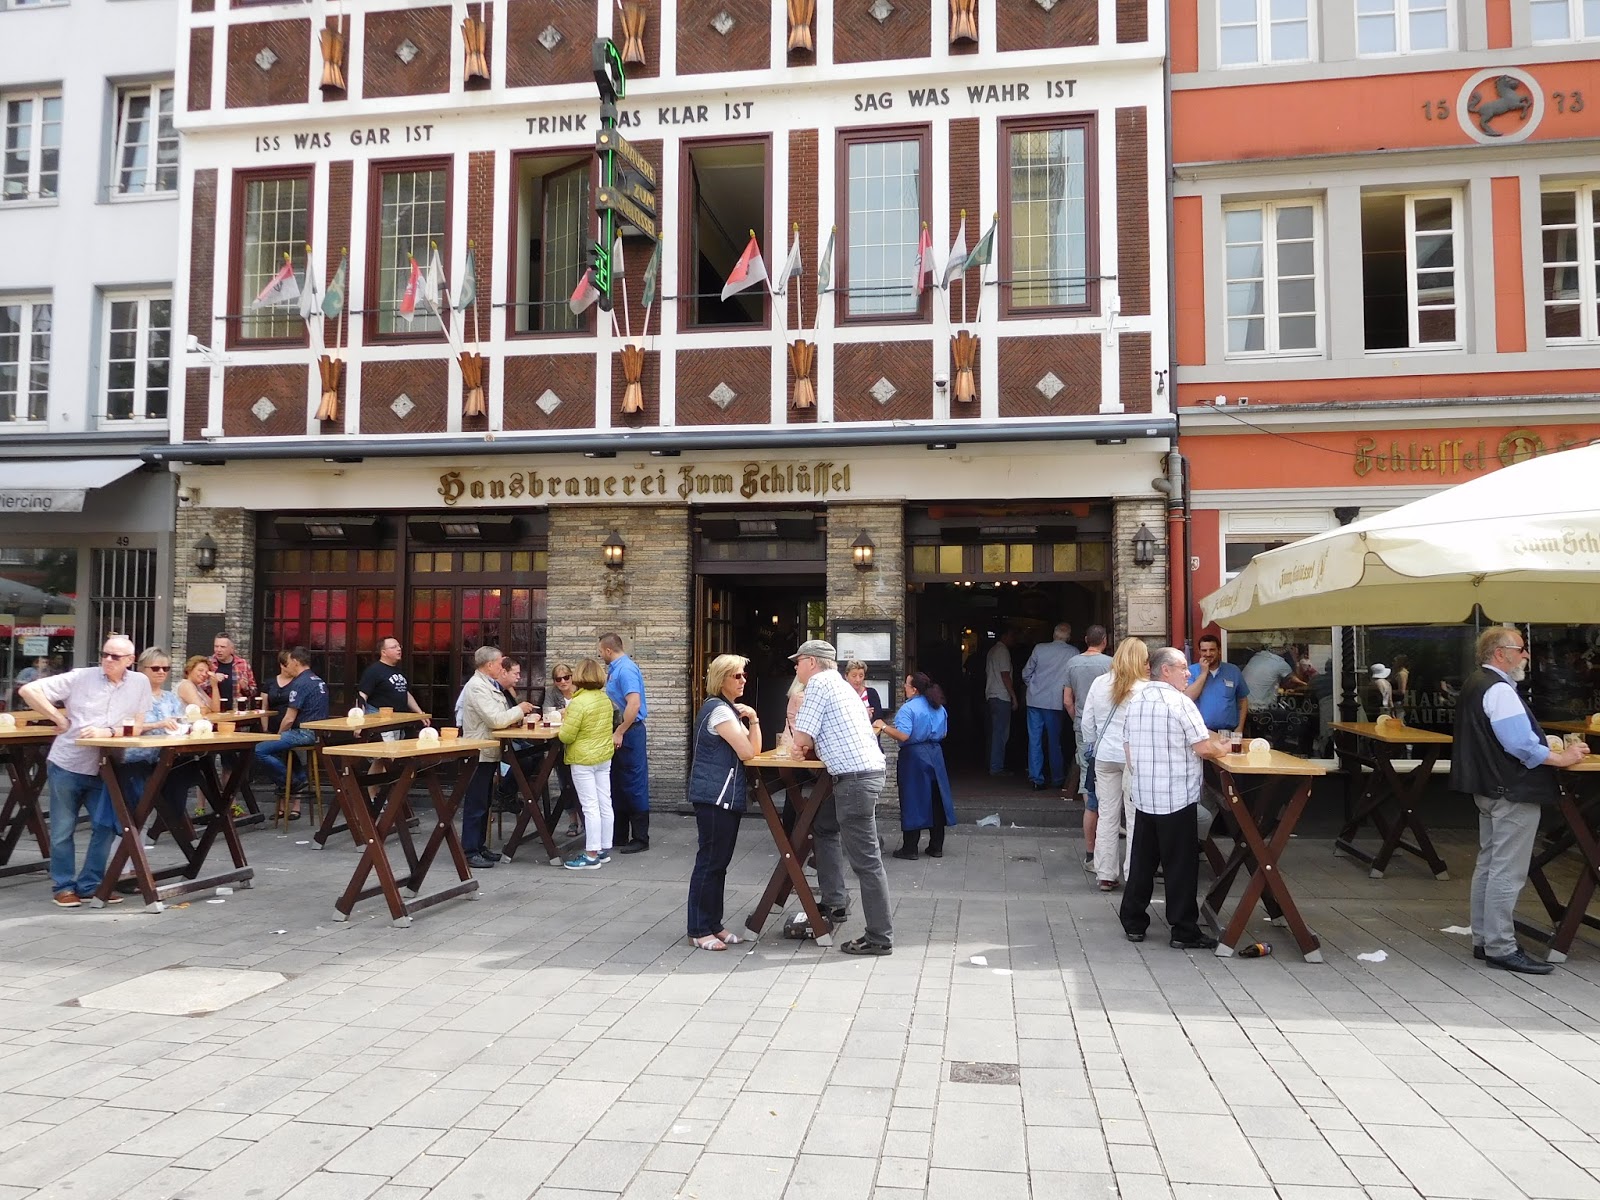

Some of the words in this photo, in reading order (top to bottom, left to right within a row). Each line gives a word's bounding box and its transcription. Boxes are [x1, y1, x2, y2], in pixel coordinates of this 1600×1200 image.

[854, 92, 893, 112] SAG
[908, 87, 949, 107] WAS
[967, 83, 1030, 103] WAHR
[1047, 79, 1077, 98] IST
[1422, 100, 1450, 121] 15
[1552, 91, 1585, 114] 73
[526, 114, 587, 134] TRINK
[617, 110, 641, 129] AS
[658, 105, 708, 125] KLAR
[725, 101, 754, 121] IST
[256, 136, 281, 152] ISS
[294, 132, 331, 150] WAS
[350, 127, 390, 146] GAR
[406, 125, 434, 143] IST
[633, 183, 655, 211] ZUM
[677, 465, 733, 500] Zum
[739, 461, 850, 500] Schlüssel
[0, 493, 52, 512] iercing
[116, 536, 130, 547] 49
[1560, 525, 1600, 556] Sch
